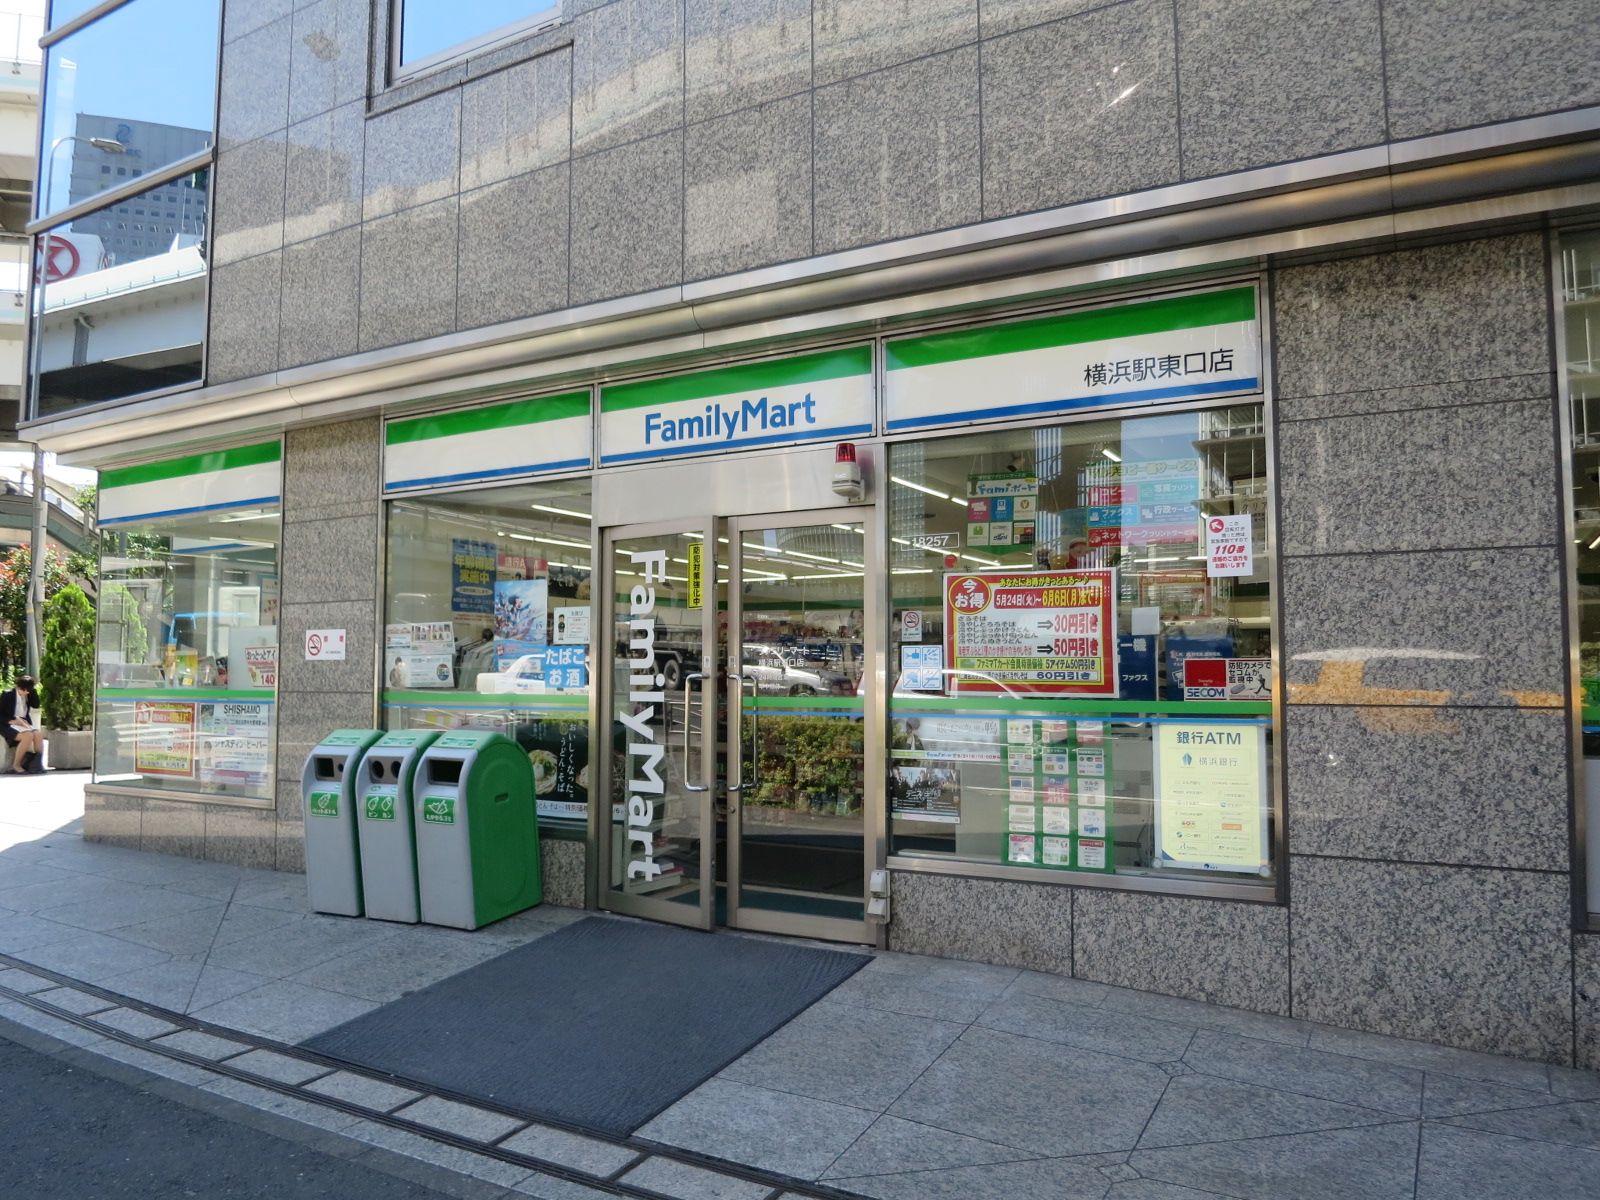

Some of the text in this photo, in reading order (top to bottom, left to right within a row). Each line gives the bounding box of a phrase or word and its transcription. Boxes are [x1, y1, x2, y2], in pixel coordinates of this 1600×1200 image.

[1084, 348, 1234, 387] 横浜駅東口店
[645, 392, 816, 444] FamilyMart
[1215, 544, 1246, 554] 110番
[963, 580, 978, 592] 今
[955, 592, 985, 609] お得
[1054, 613, 1098, 634] 30円引き
[1054, 638, 1098, 658] 50円引き
[545, 648, 585, 666] たばこ
[549, 668, 580, 687] お酒
[1036, 671, 1090, 680] 60円引き
[1187, 688, 1224, 697] SECOM
[224, 704, 260, 715] SHISHAMO
[620, 550, 666, 882] FamilyMart
[1176, 731, 1242, 745] 銀行ATM
[1199, 756, 1237, 767] 横浜銀行
